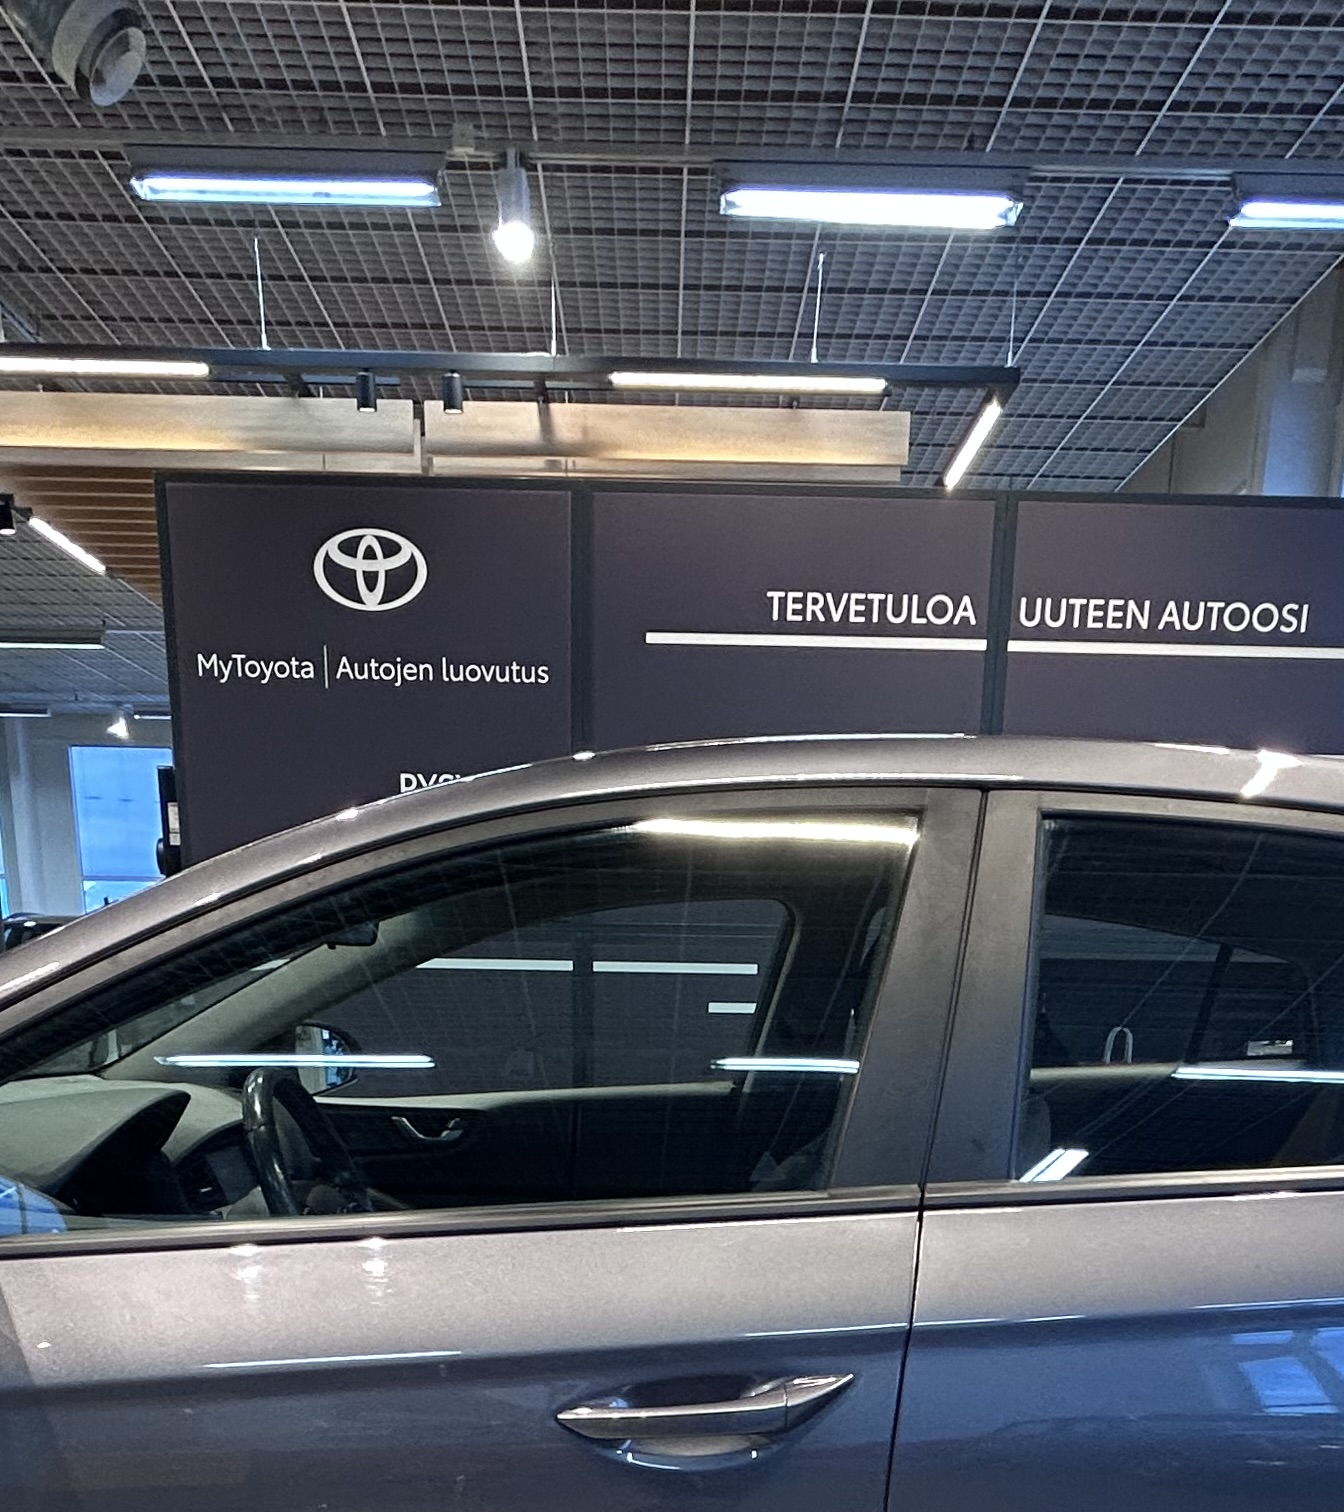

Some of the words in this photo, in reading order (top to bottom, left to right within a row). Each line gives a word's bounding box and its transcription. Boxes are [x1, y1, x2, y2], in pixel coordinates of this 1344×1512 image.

[766, 590, 977, 626] TERVETULOA
[1018, 597, 1151, 631] UUTEEN
[1157, 602, 1310, 635] AUTOOSI
[196, 653, 315, 683] MyToyota
[335, 655, 434, 687] Autojen
[442, 656, 550, 684] luovutus
